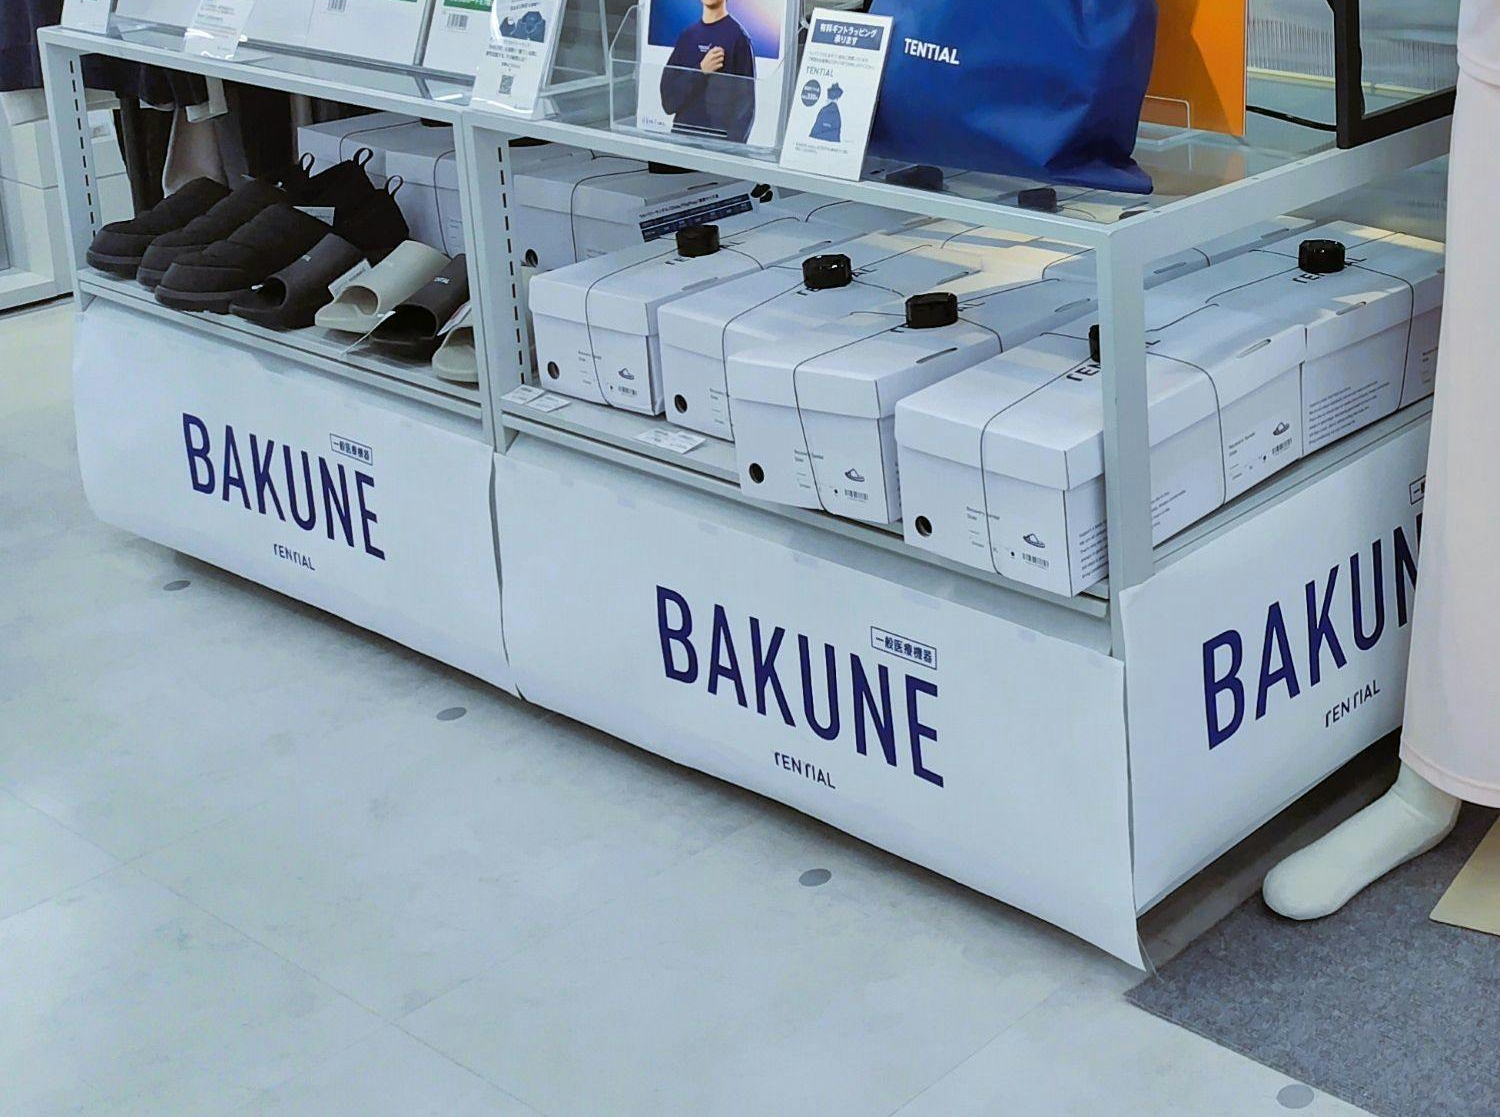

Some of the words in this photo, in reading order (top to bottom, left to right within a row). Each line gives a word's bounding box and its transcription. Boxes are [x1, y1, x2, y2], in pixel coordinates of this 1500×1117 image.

[904, 38, 960, 65] TENTIAL
[806, 66, 835, 78] TENTIAL
[183, 412, 386, 561] BAKUNE
[273, 543, 315, 571] TENTIAL
[875, 635, 933, 664] 一般医療機器
[656, 584, 944, 789] BAKUNE
[1324, 679, 1381, 728] TENTIAL
[774, 751, 836, 790] TENTIAL
